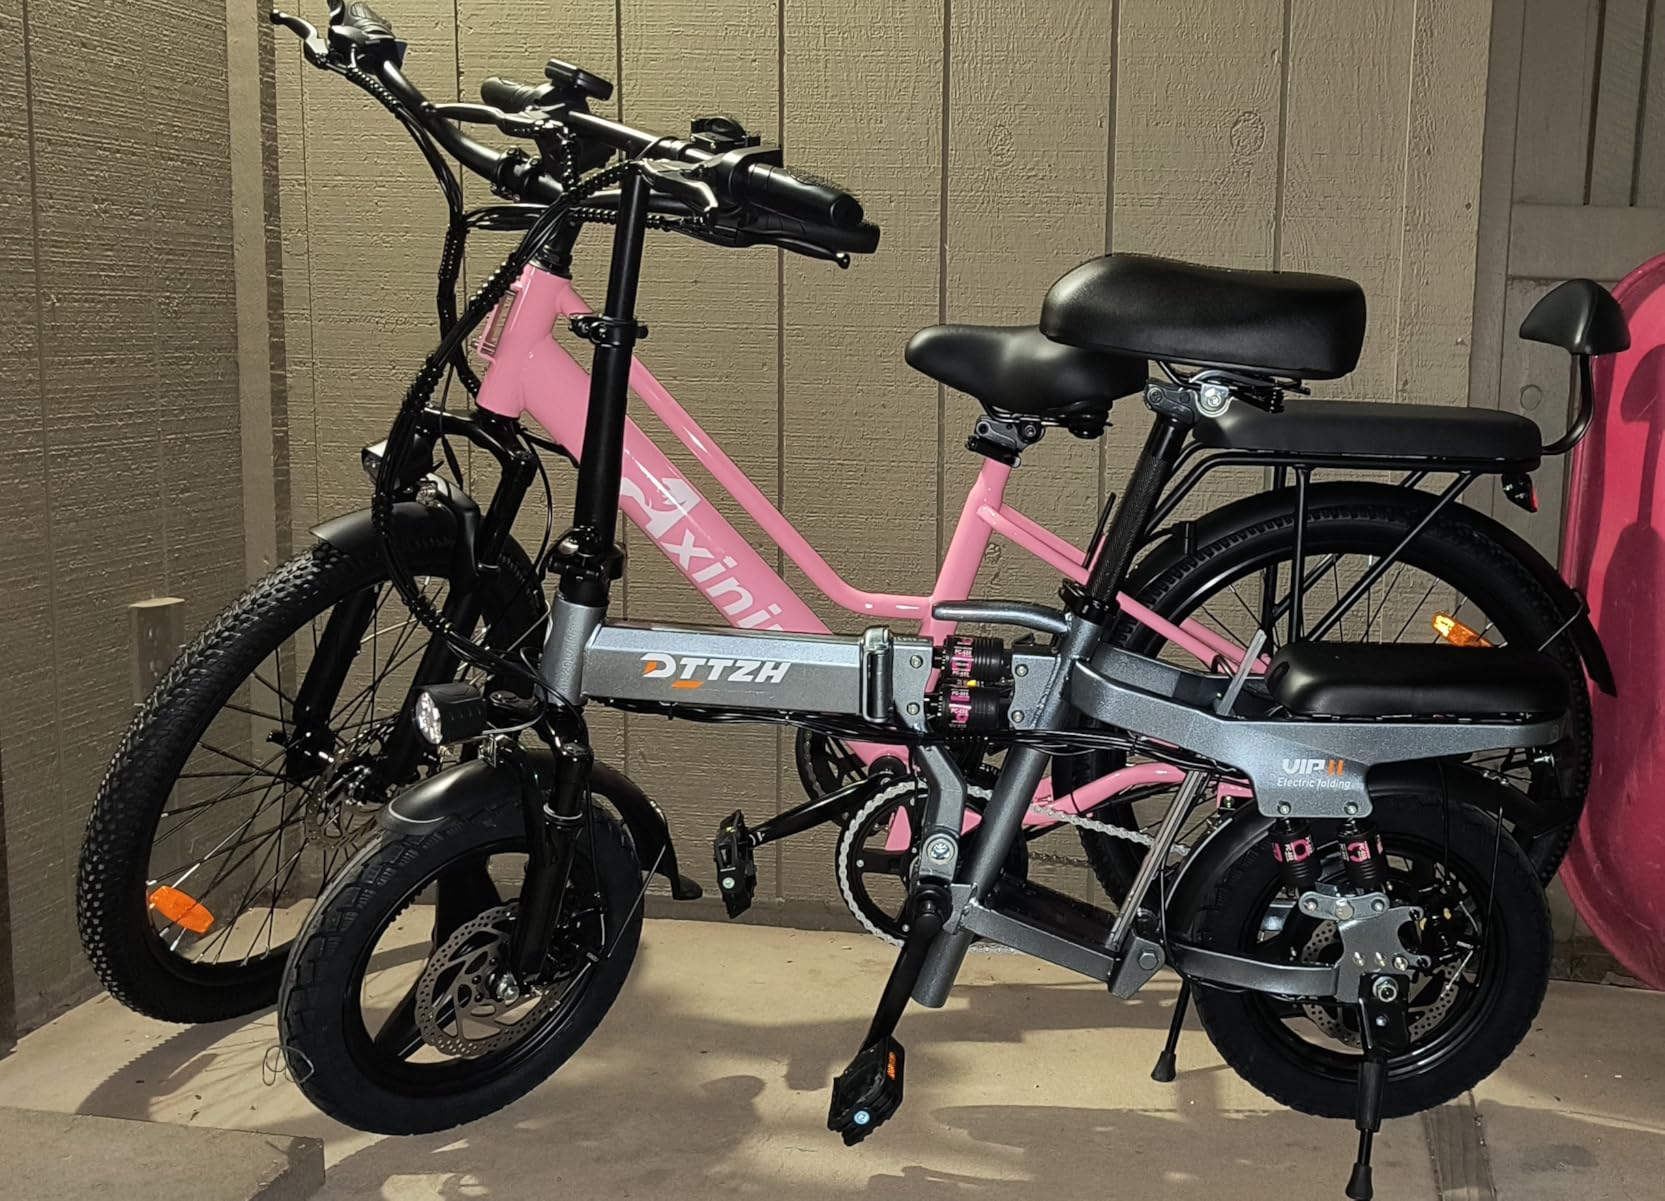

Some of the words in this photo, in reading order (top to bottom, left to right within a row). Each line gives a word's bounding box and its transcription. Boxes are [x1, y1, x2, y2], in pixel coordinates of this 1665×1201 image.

[620, 477, 784, 632] Axini
[640, 653, 792, 684] DTTZH
[1277, 777, 1315, 788] Electric
